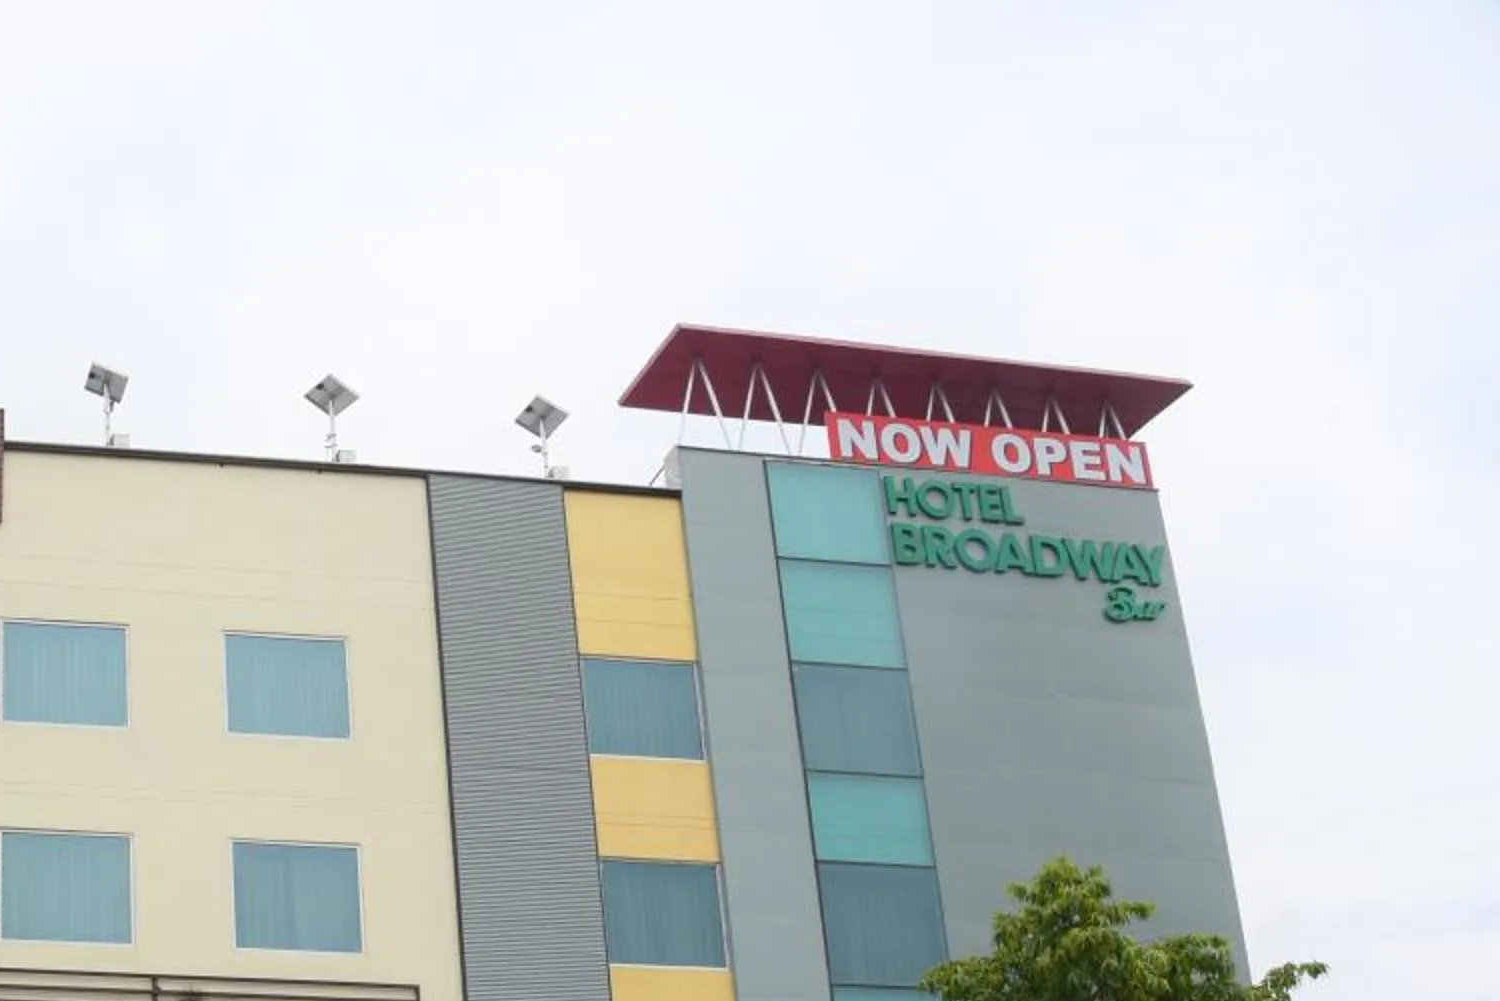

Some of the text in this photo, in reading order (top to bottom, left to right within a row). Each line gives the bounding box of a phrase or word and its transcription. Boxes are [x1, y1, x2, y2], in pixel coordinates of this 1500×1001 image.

[836, 418, 1147, 484] NOW OPEN
[883, 475, 1025, 525] HOTEL
[889, 522, 1166, 587] BROADWAY
